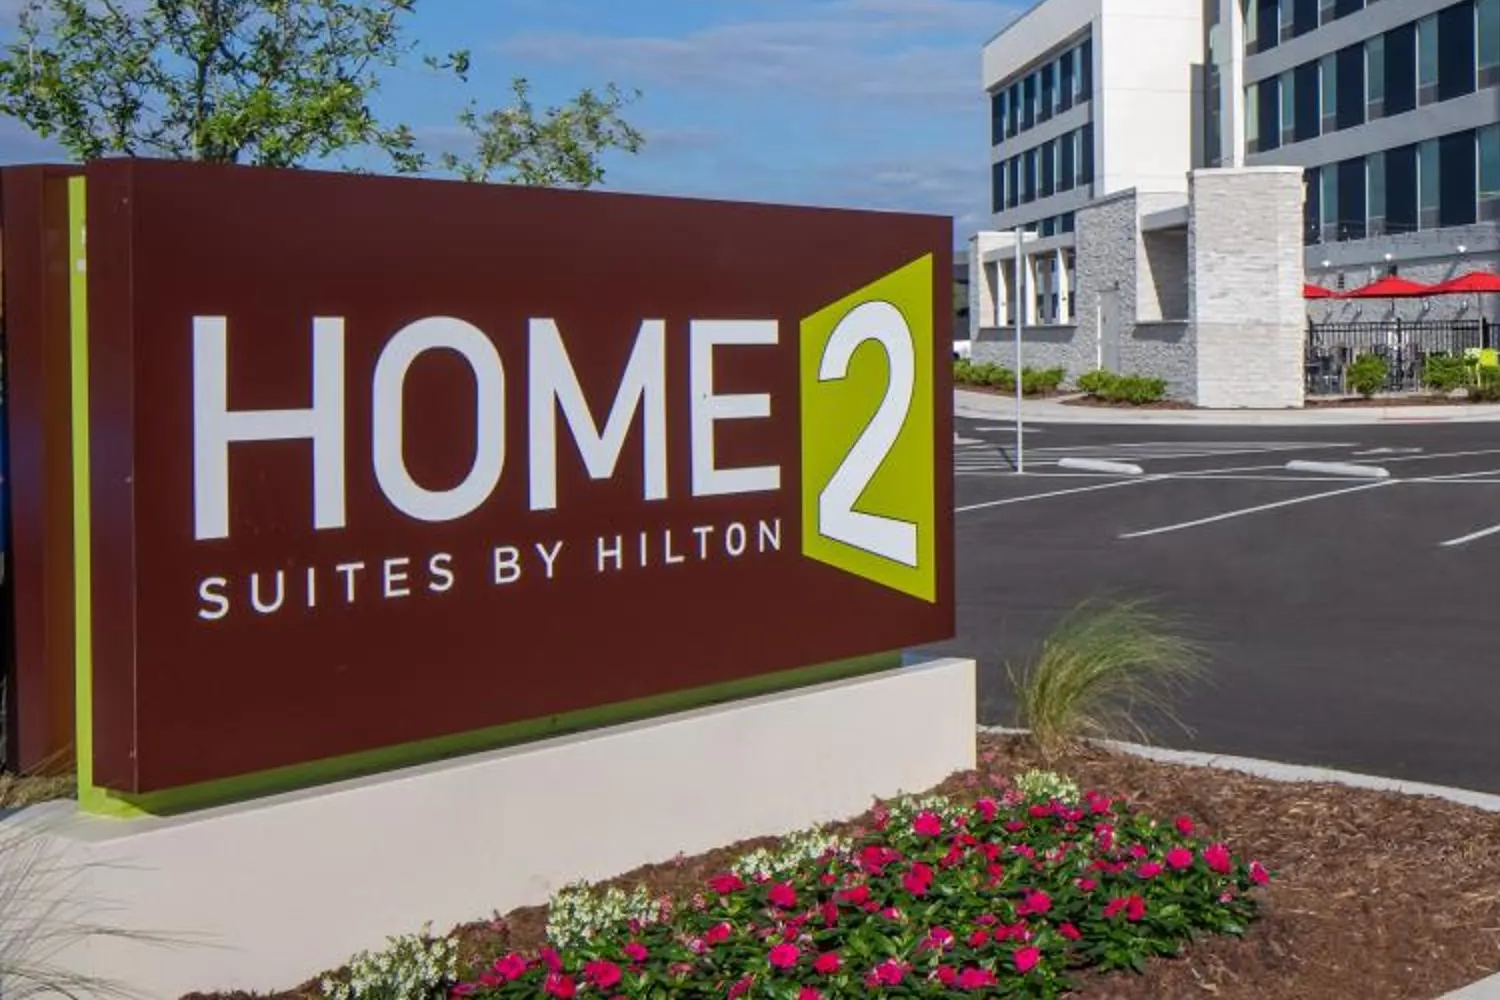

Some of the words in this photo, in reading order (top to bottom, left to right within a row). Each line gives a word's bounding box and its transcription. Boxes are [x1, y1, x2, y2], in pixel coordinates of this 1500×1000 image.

[198, 553, 454, 620] SUITES
[495, 541, 563, 585] BY
[597, 519, 782, 572] HILTON
